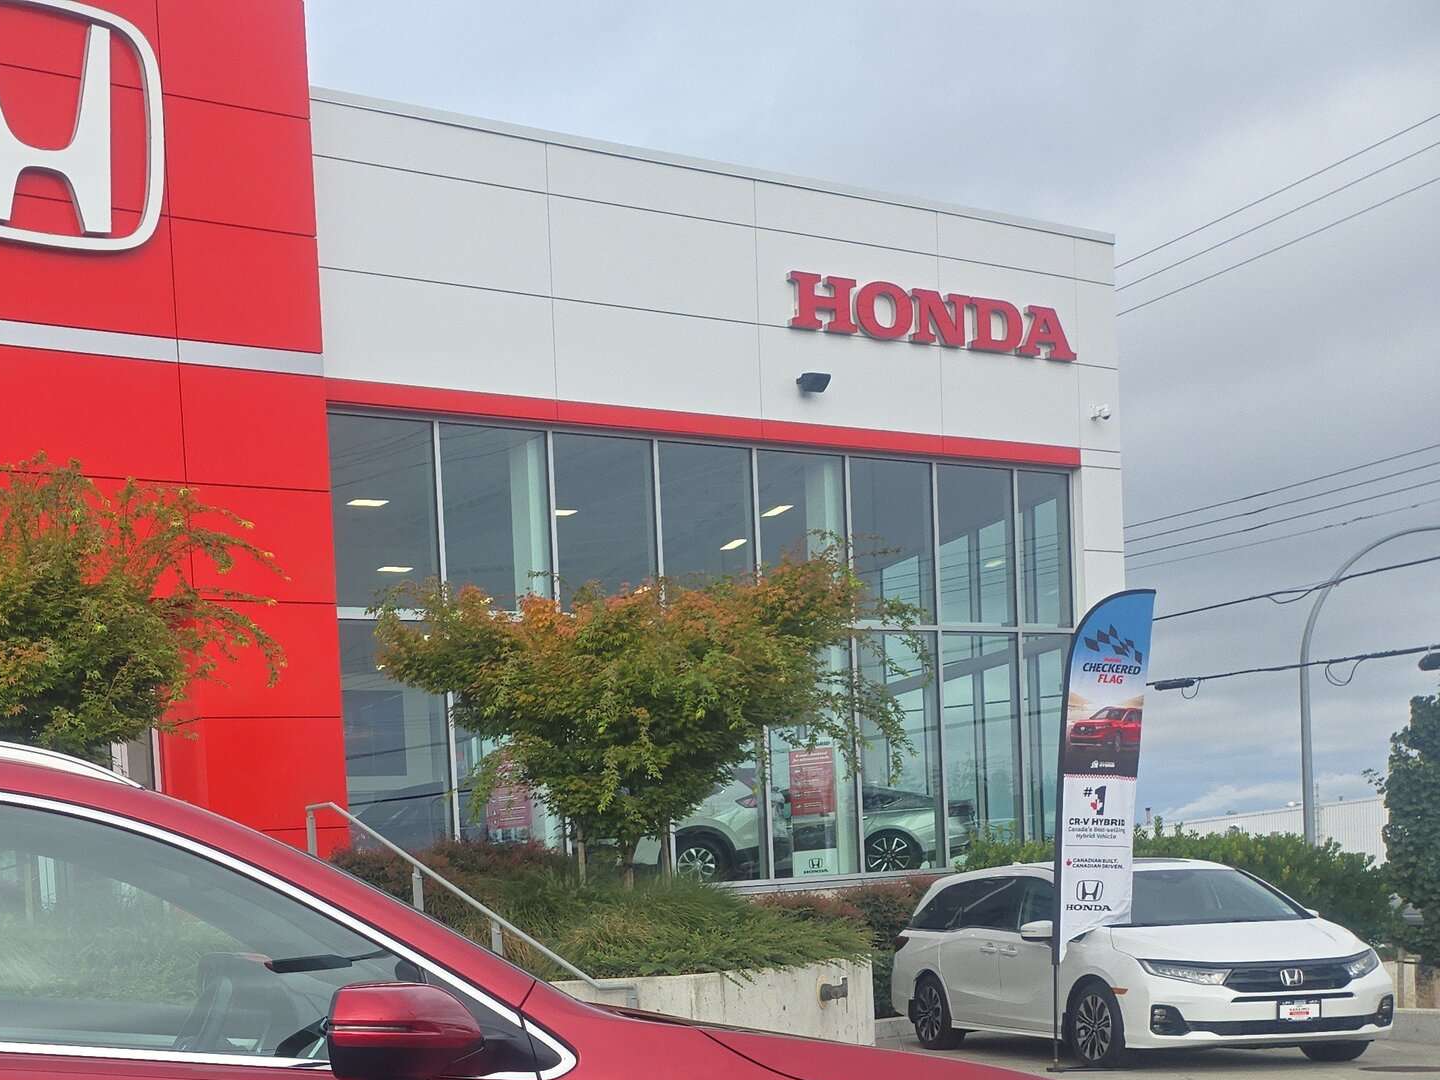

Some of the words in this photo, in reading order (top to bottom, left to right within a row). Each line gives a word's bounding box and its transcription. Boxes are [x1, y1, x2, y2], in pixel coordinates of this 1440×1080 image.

[786, 270, 1077, 362] HONDA
[1082, 662, 1141, 676] CHECKERED
[1097, 673, 1124, 685] FLAG
[1068, 817, 1090, 826] CR-V
[1091, 817, 1126, 827] HYBRID
[1065, 903, 1112, 912] HONDA
